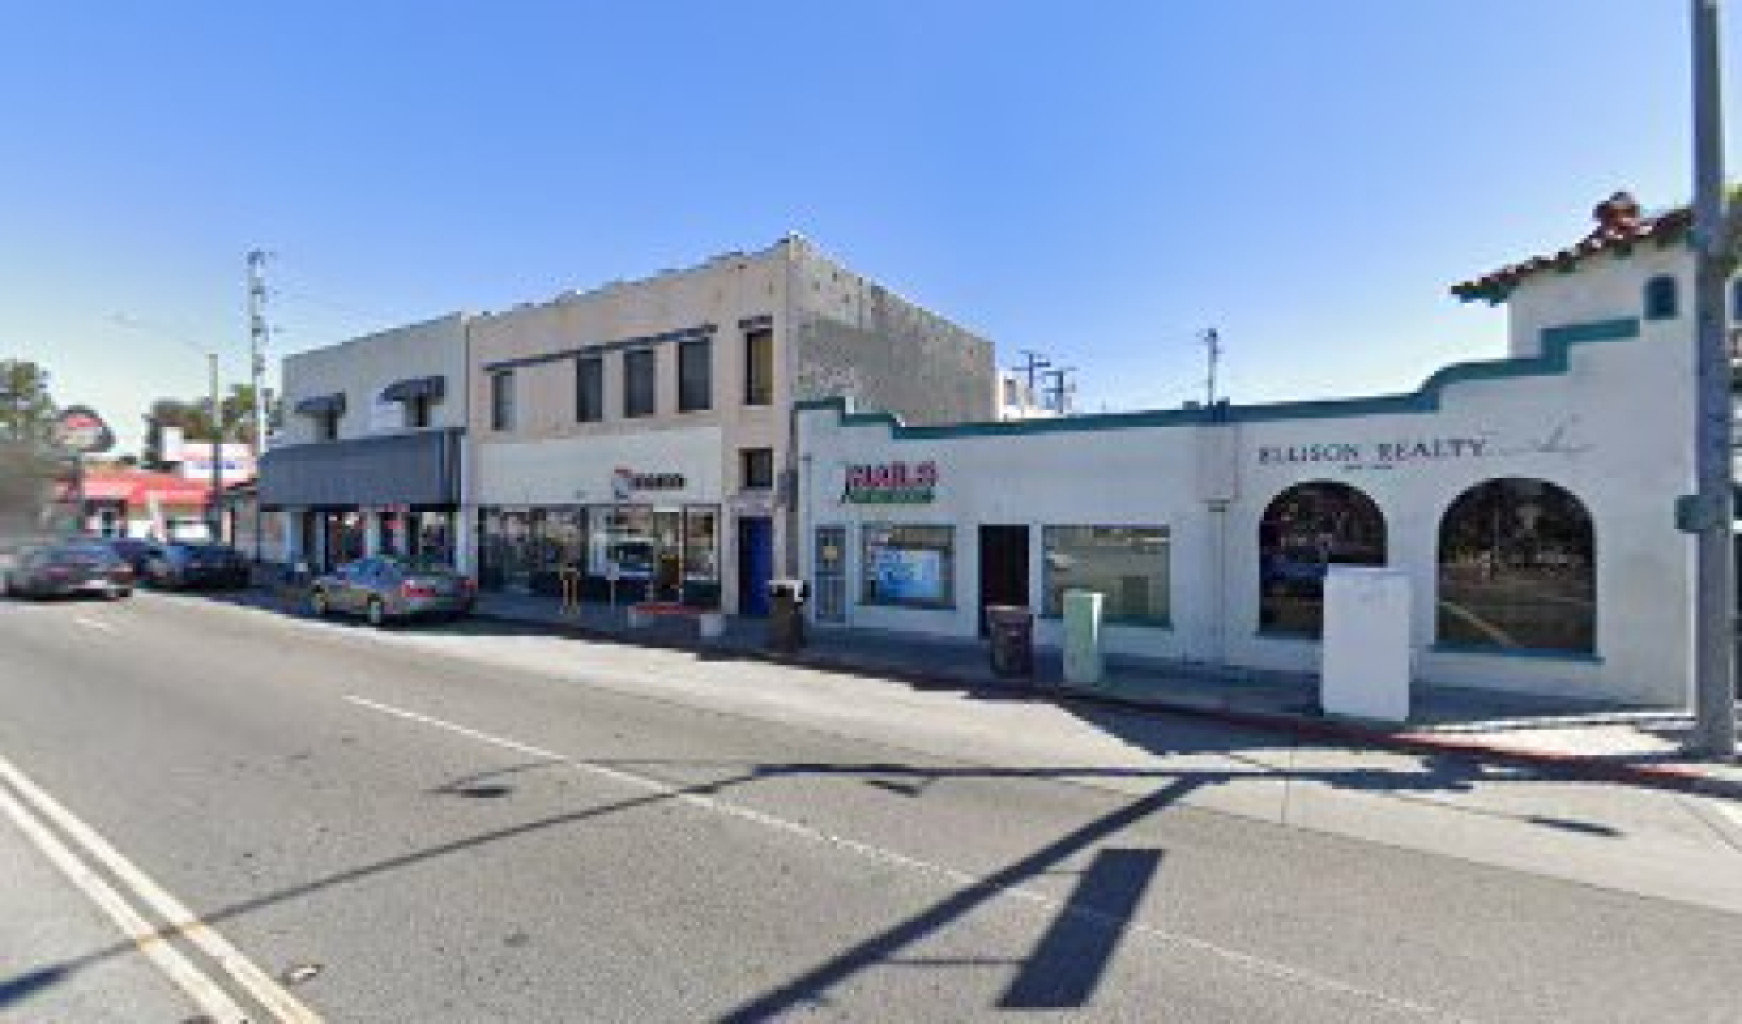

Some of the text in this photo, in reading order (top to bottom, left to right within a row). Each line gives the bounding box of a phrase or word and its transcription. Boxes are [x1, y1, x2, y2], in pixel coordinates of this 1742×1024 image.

[1258, 438, 1486, 464] ELLISON REALTY
[852, 461, 938, 487] NAILS
